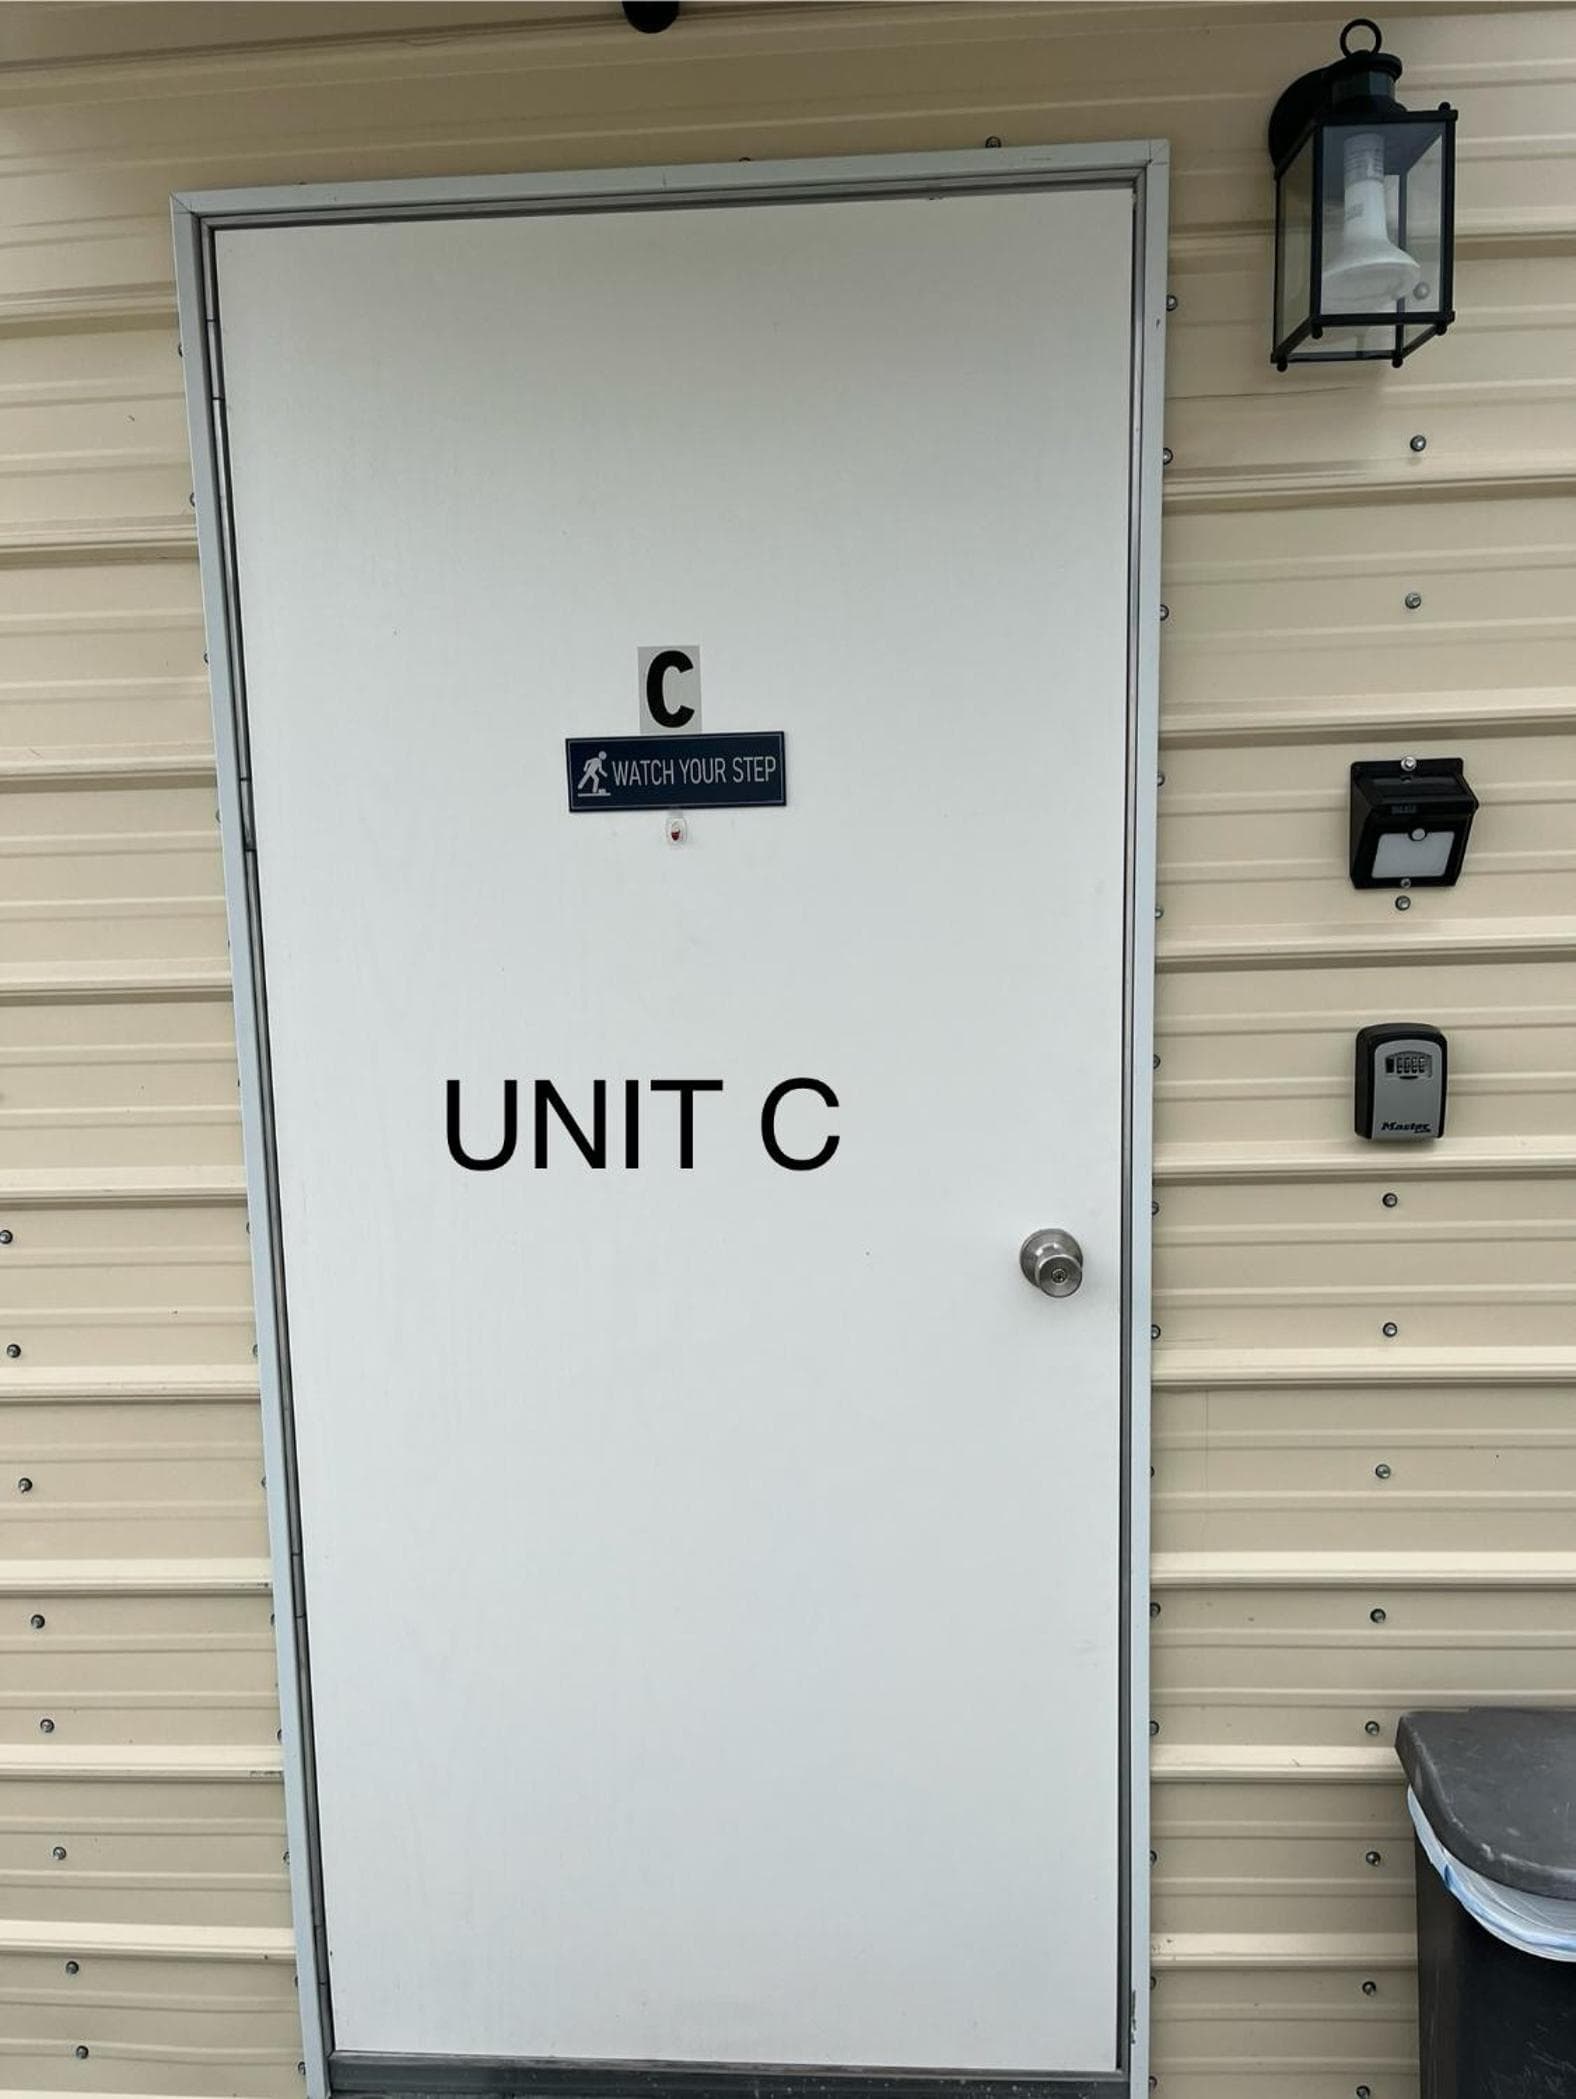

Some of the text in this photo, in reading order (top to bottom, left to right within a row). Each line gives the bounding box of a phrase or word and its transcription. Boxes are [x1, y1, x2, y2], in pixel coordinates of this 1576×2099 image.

[646, 650, 695, 728] C
[612, 756, 776, 786] WATCH YOUR STEP
[1381, 1122, 1431, 1133] Master
